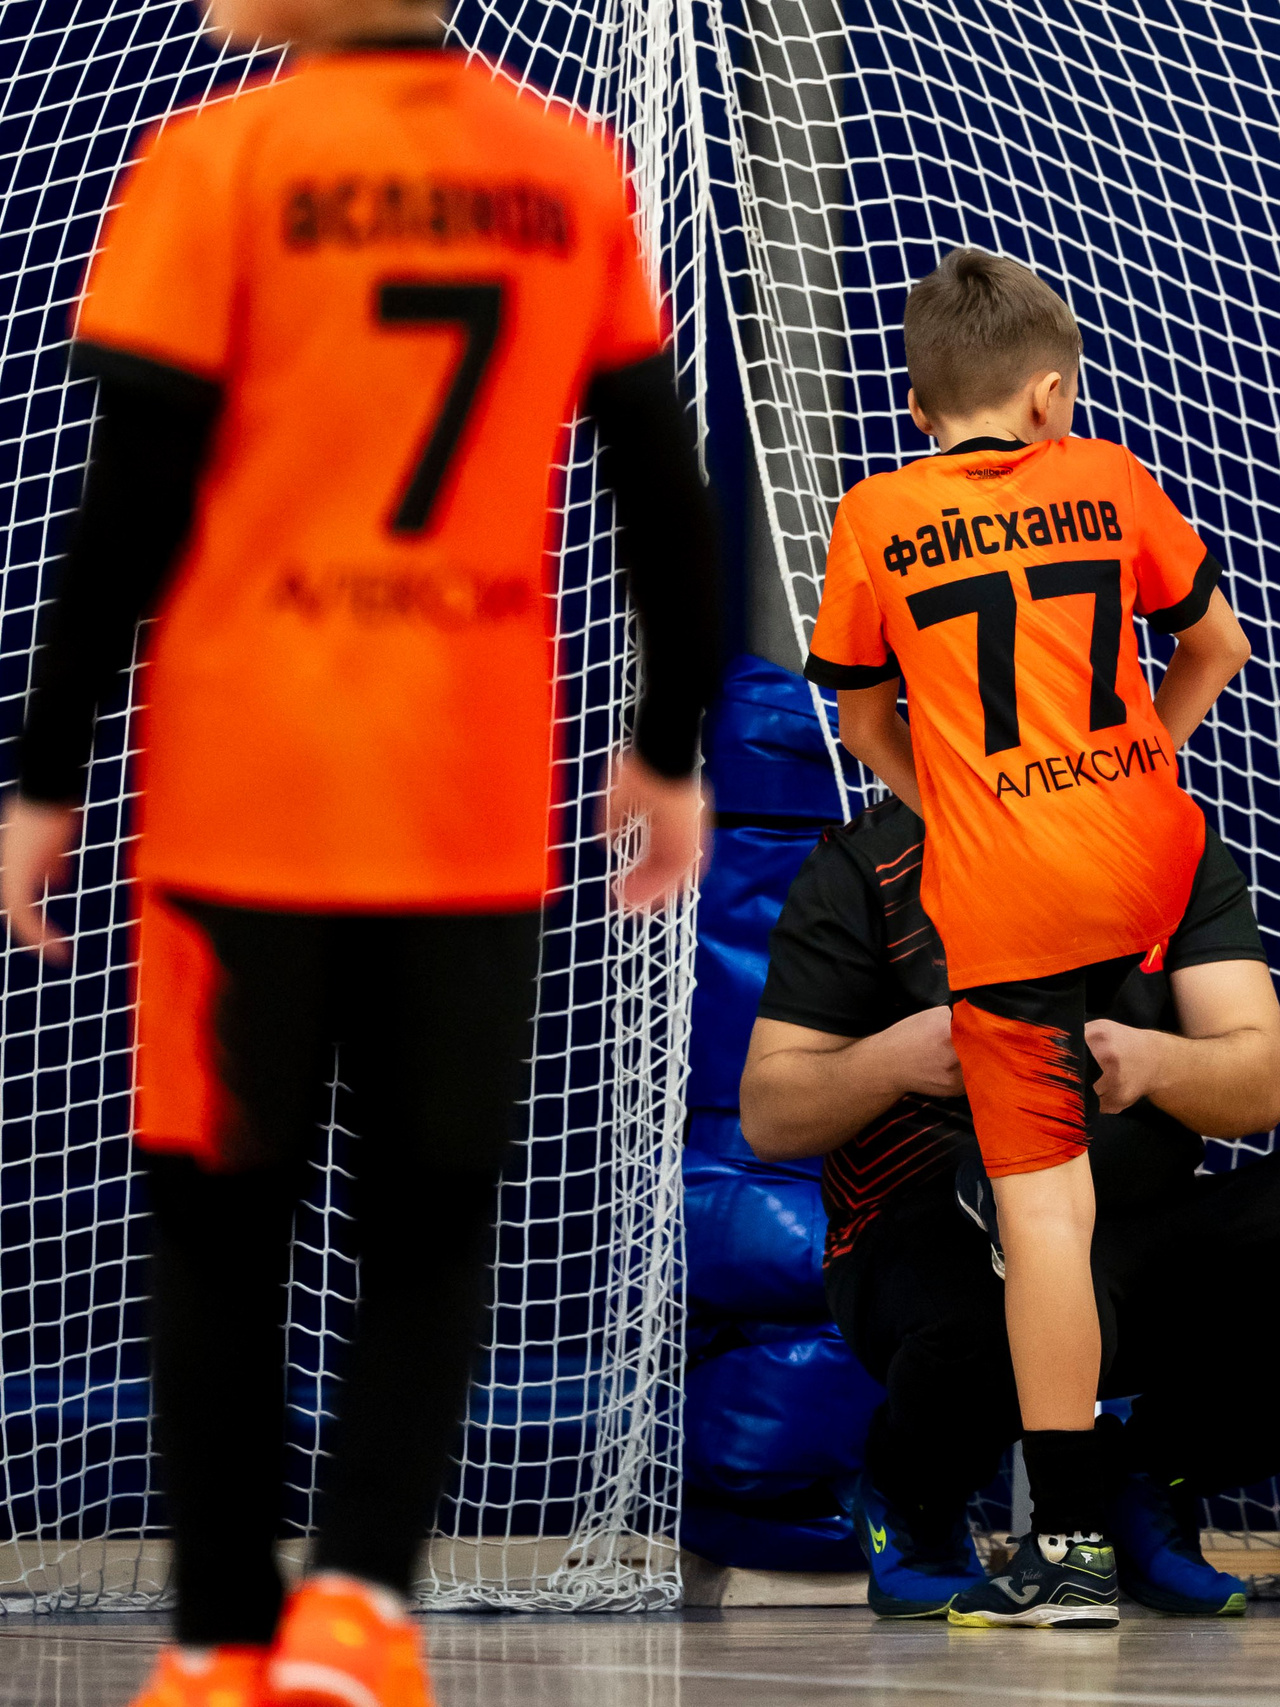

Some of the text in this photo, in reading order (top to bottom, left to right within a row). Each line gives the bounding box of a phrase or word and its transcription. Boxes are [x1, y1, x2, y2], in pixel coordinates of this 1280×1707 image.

[375, 277, 509, 537] 7
[905, 559, 1127, 757] 77
[996, 736, 1170, 798] АЛЕКСИН
